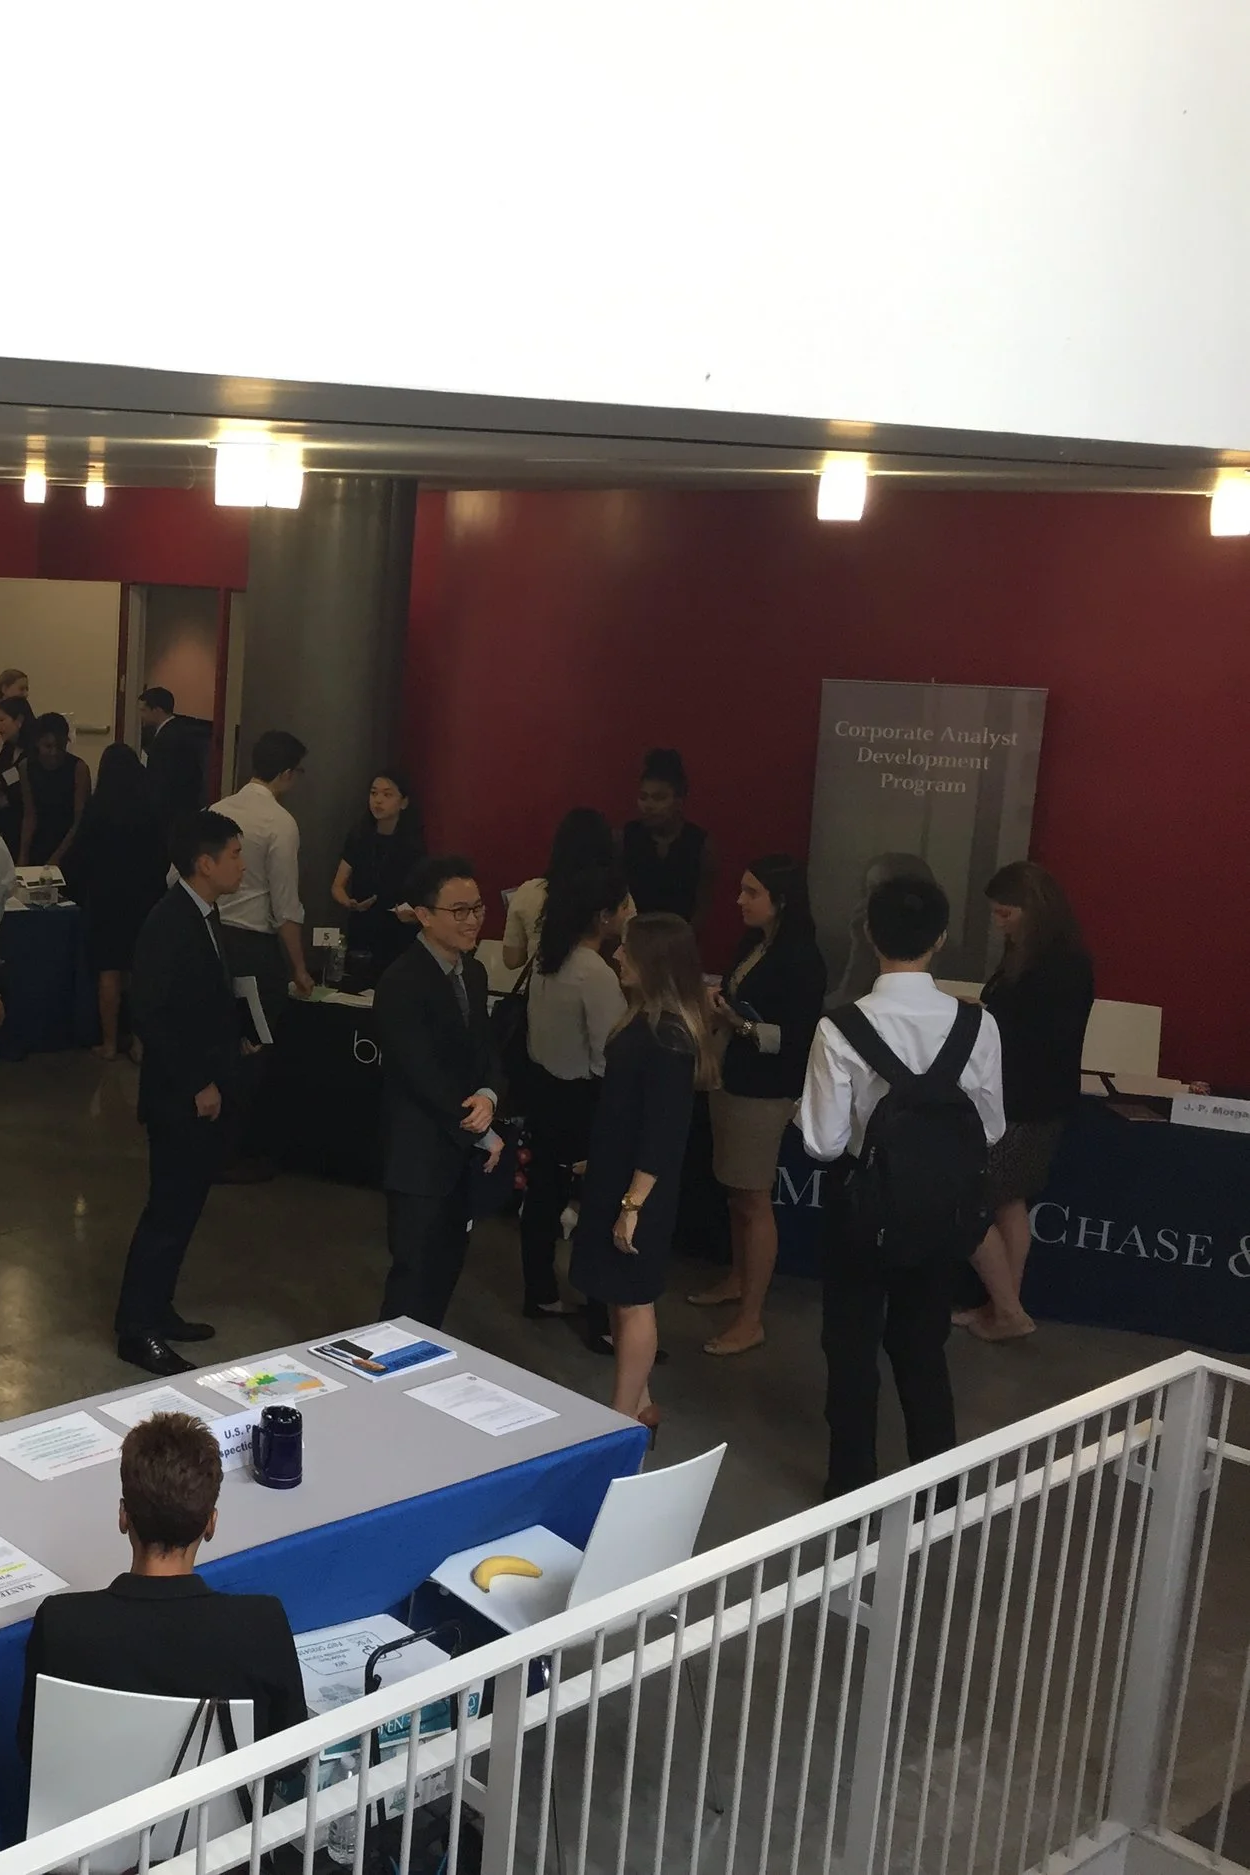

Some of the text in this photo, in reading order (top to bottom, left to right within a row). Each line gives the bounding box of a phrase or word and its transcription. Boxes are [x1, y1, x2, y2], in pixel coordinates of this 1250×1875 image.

[834, 721, 1019, 749] Corporate Analyst
[857, 747, 989, 770] Development
[880, 773, 967, 796] Program
[323, 932, 330, 941] 5
[1029, 1202, 1214, 1268] CHASE
[224, 1427, 244, 1439] U.S.
